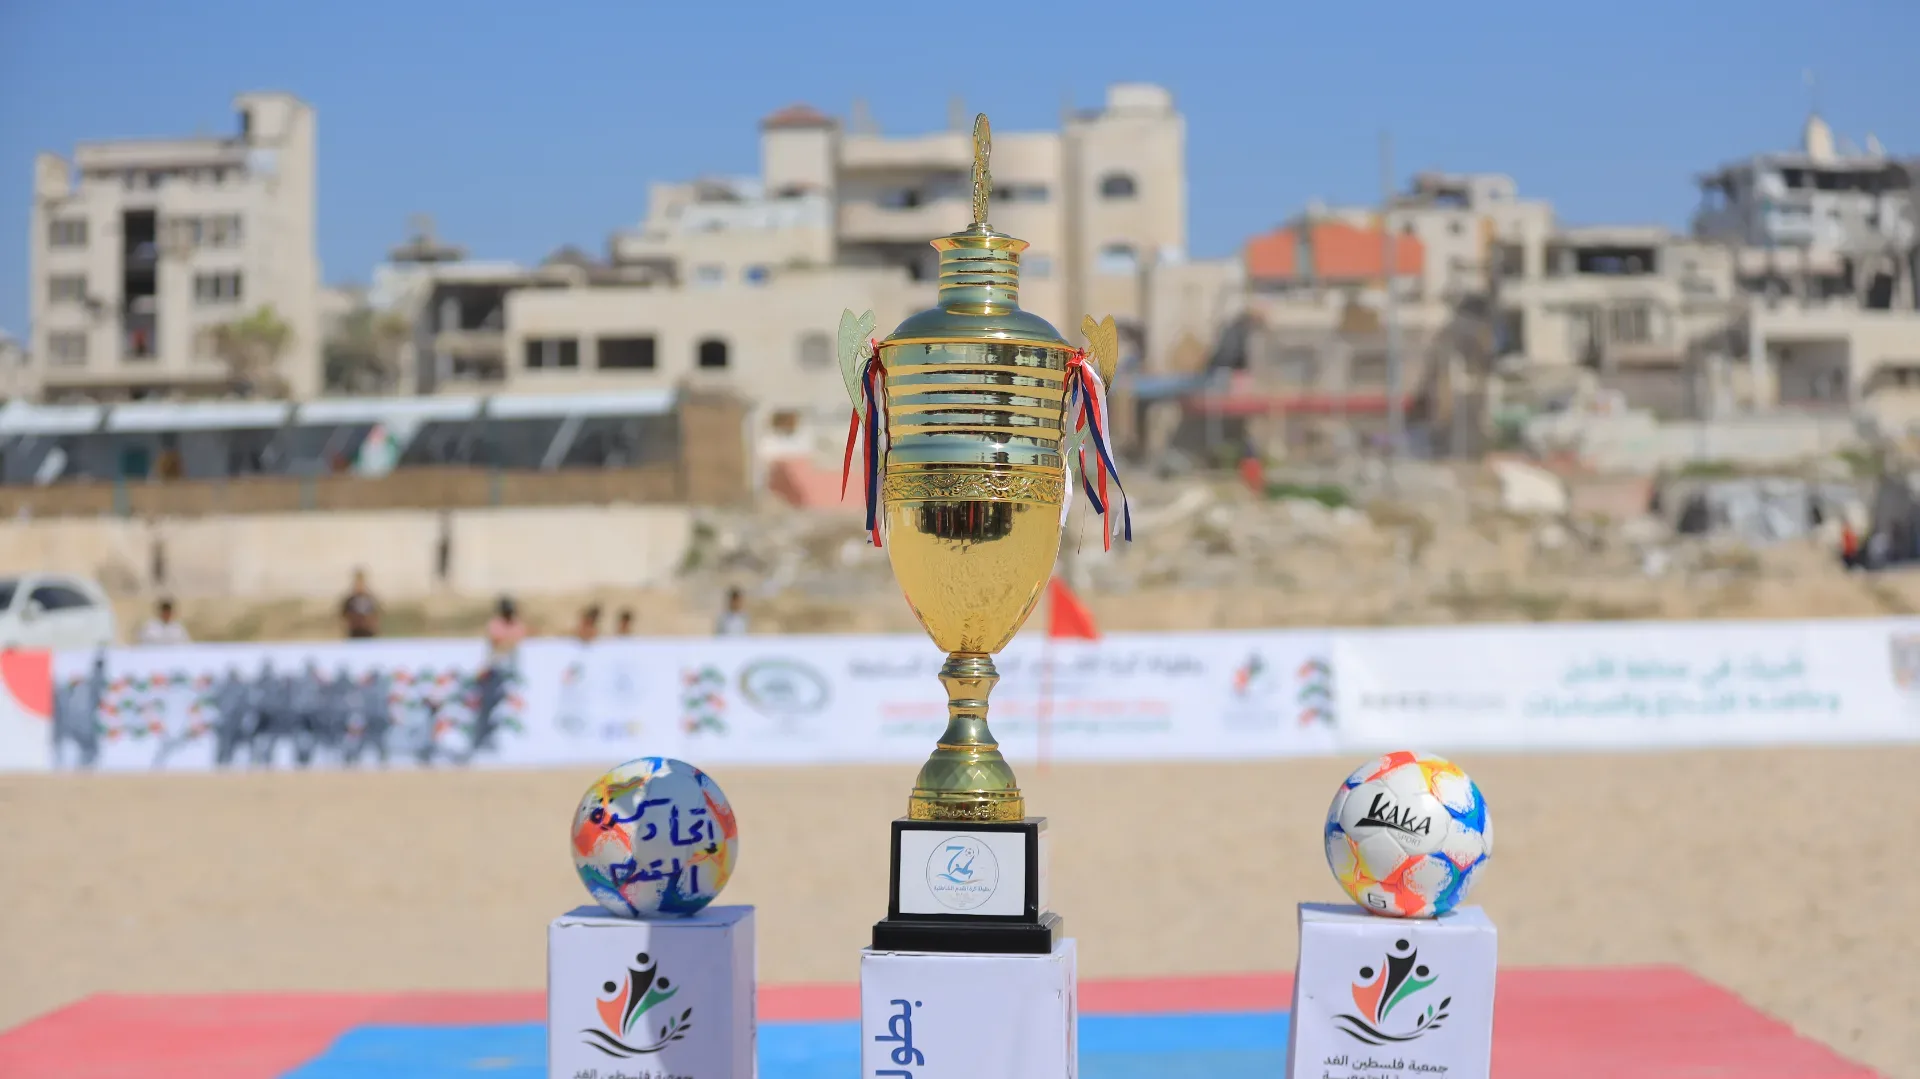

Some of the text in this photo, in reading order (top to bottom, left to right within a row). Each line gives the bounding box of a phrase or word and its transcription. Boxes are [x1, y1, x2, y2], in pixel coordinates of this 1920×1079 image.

[1367, 792, 1432, 836] KAKA
[1396, 831, 1422, 848] SPORT
[874, 998, 925, 1079] بطول
[1352, 1056, 1405, 1071] فلسطين
[1408, 1060, 1449, 1074] جمعية
